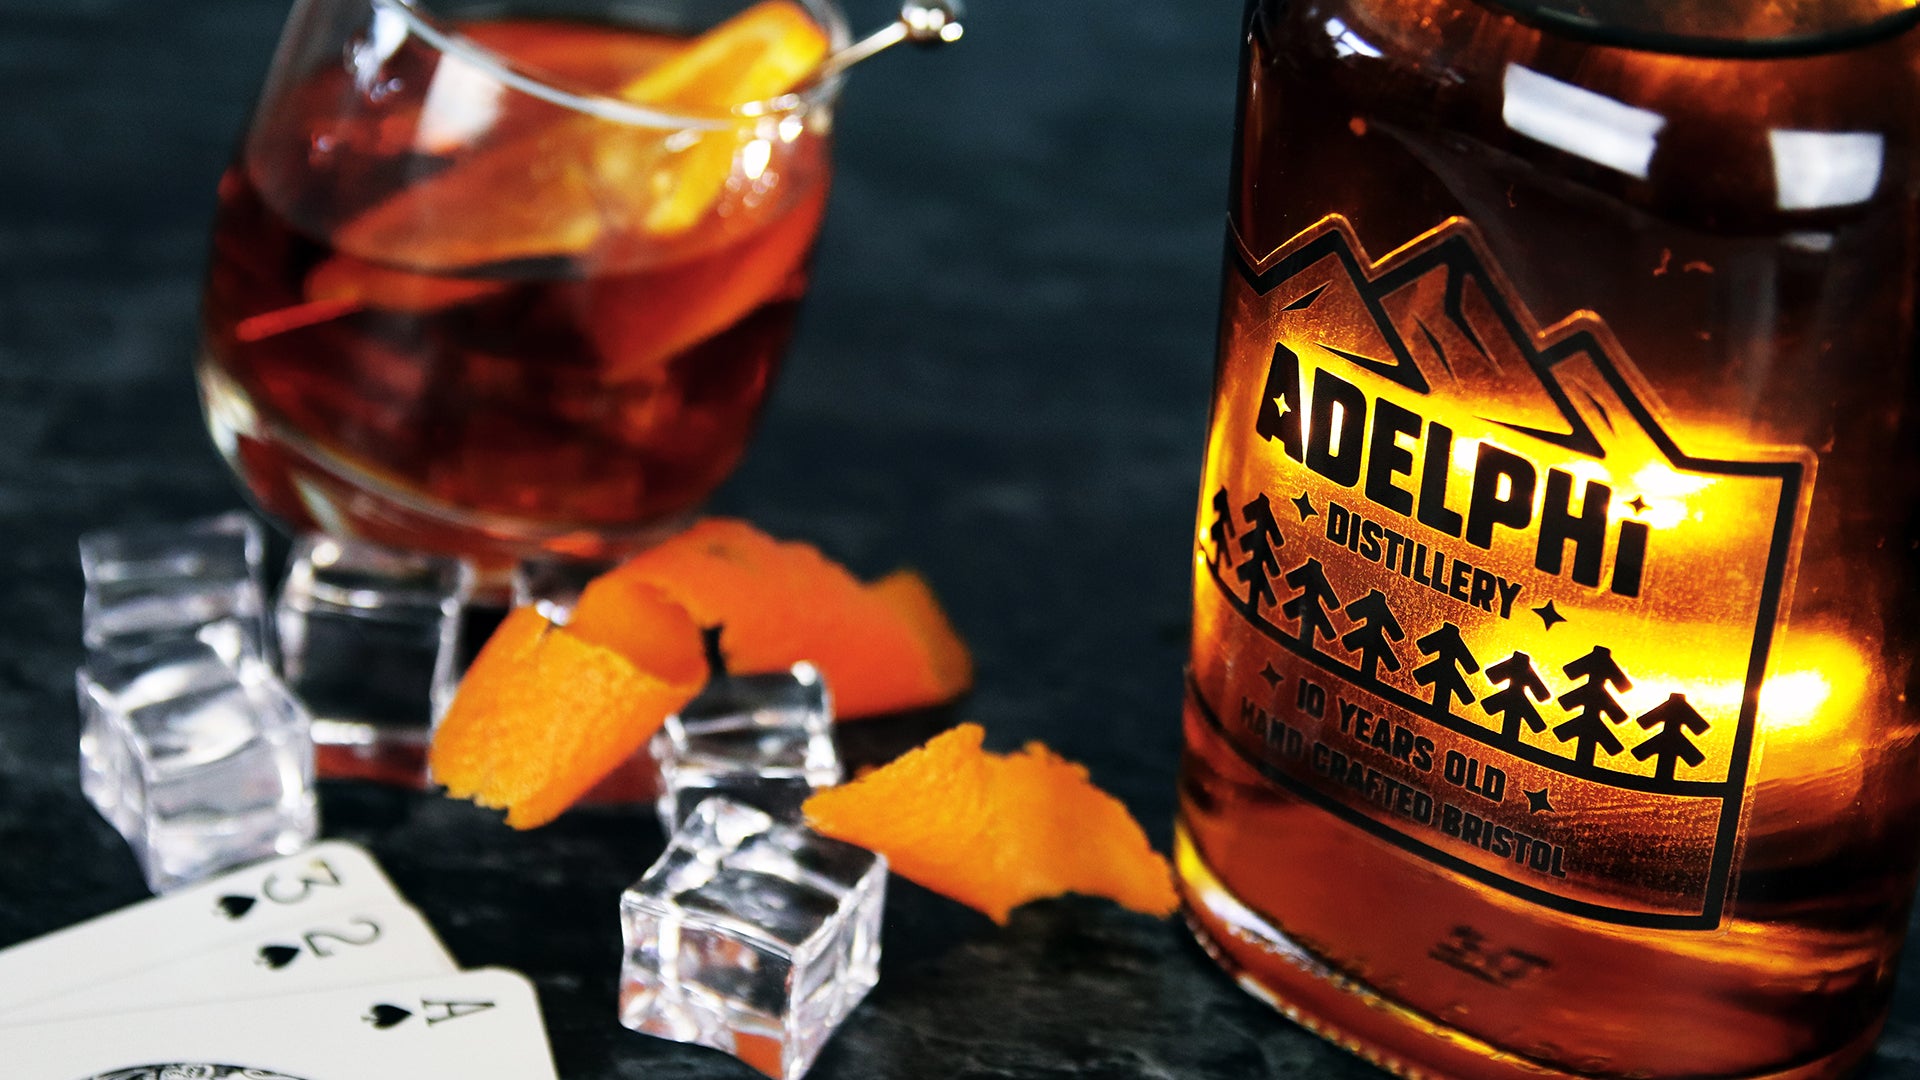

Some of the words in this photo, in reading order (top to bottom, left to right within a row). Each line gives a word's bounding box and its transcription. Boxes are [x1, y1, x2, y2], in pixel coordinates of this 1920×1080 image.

[1325, 506, 1523, 619] DISTILLERY
[1296, 677, 1327, 721] 10
[1336, 697, 1435, 774] YEARS
[1444, 749, 1507, 804] OLD
[1240, 696, 1304, 755] HAND
[1312, 741, 1434, 825] CRAFTED
[1441, 802, 1567, 879] BRISTOL
[262, 860, 342, 905] 3
[303, 917, 382, 957] 2
[421, 999, 498, 1026] A
